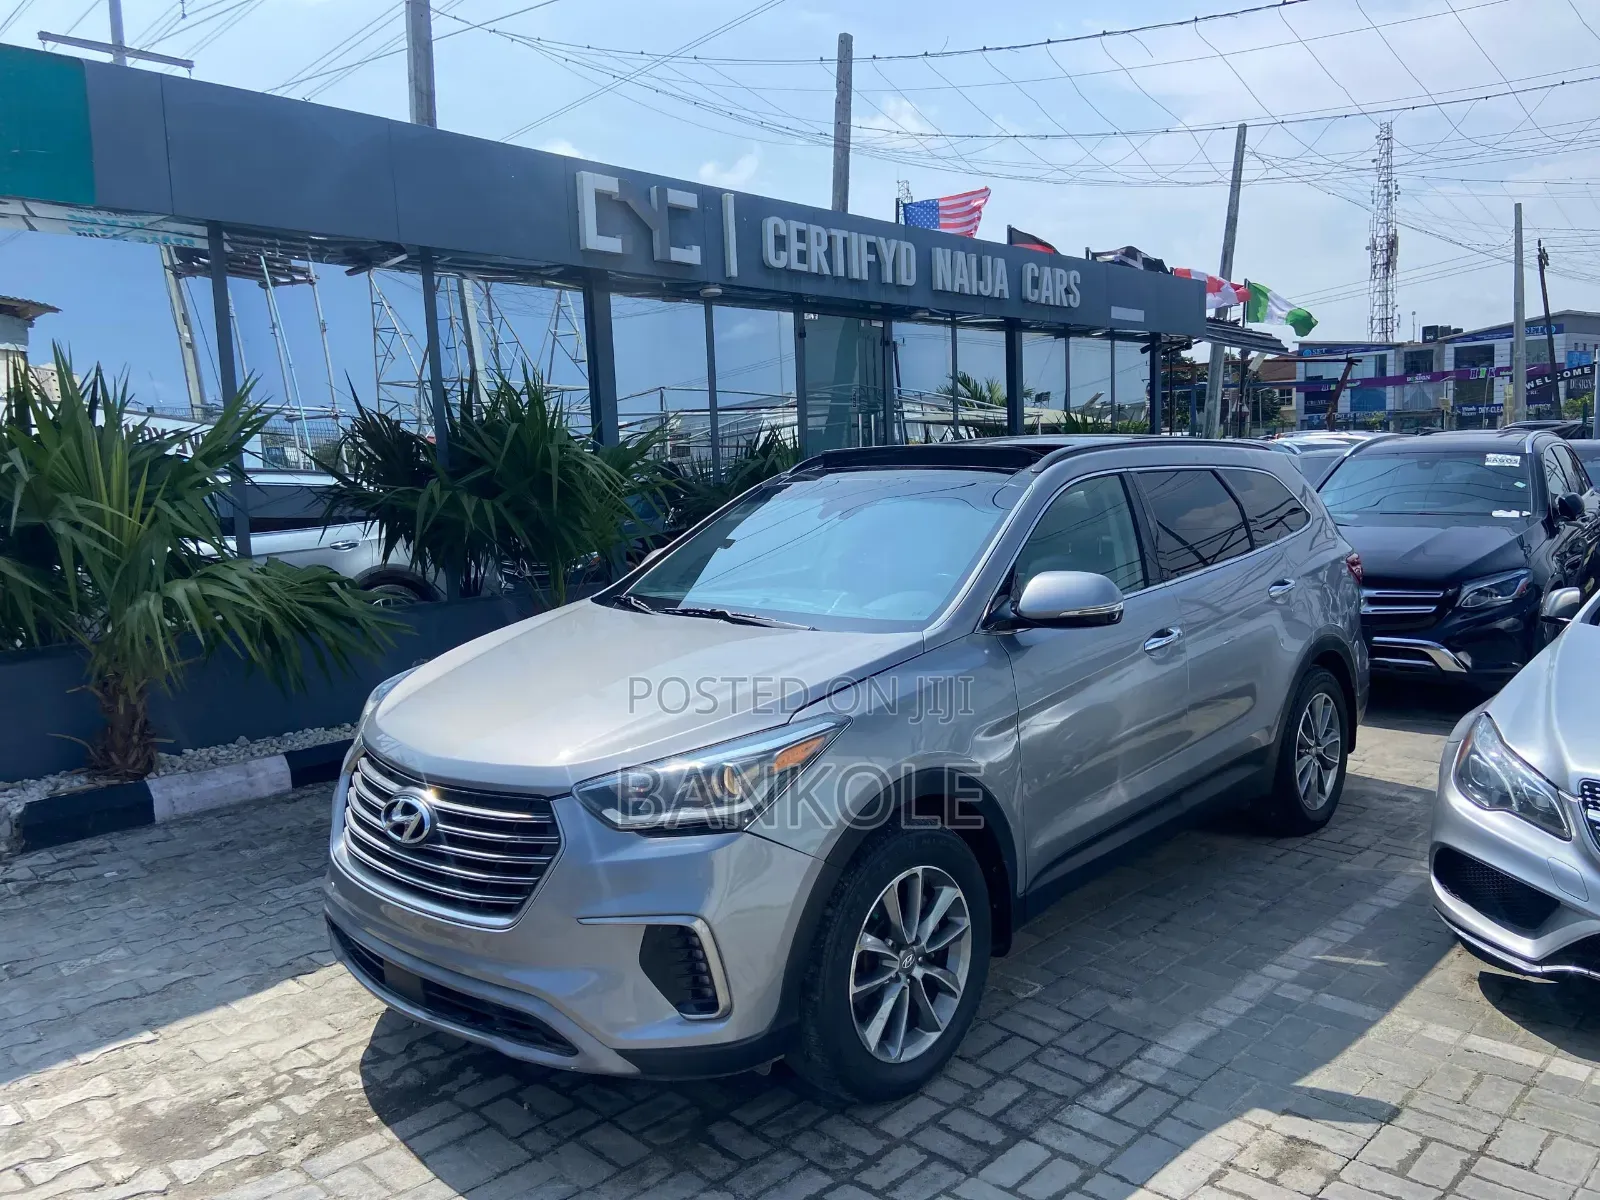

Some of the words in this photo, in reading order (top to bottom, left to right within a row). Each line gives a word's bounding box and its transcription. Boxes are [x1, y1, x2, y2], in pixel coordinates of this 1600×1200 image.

[762, 216, 917, 287] CERTIFYD
[931, 247, 1009, 299] NAIJA
[1021, 262, 1081, 308] CARS
[1526, 366, 1591, 390] WELCOME
